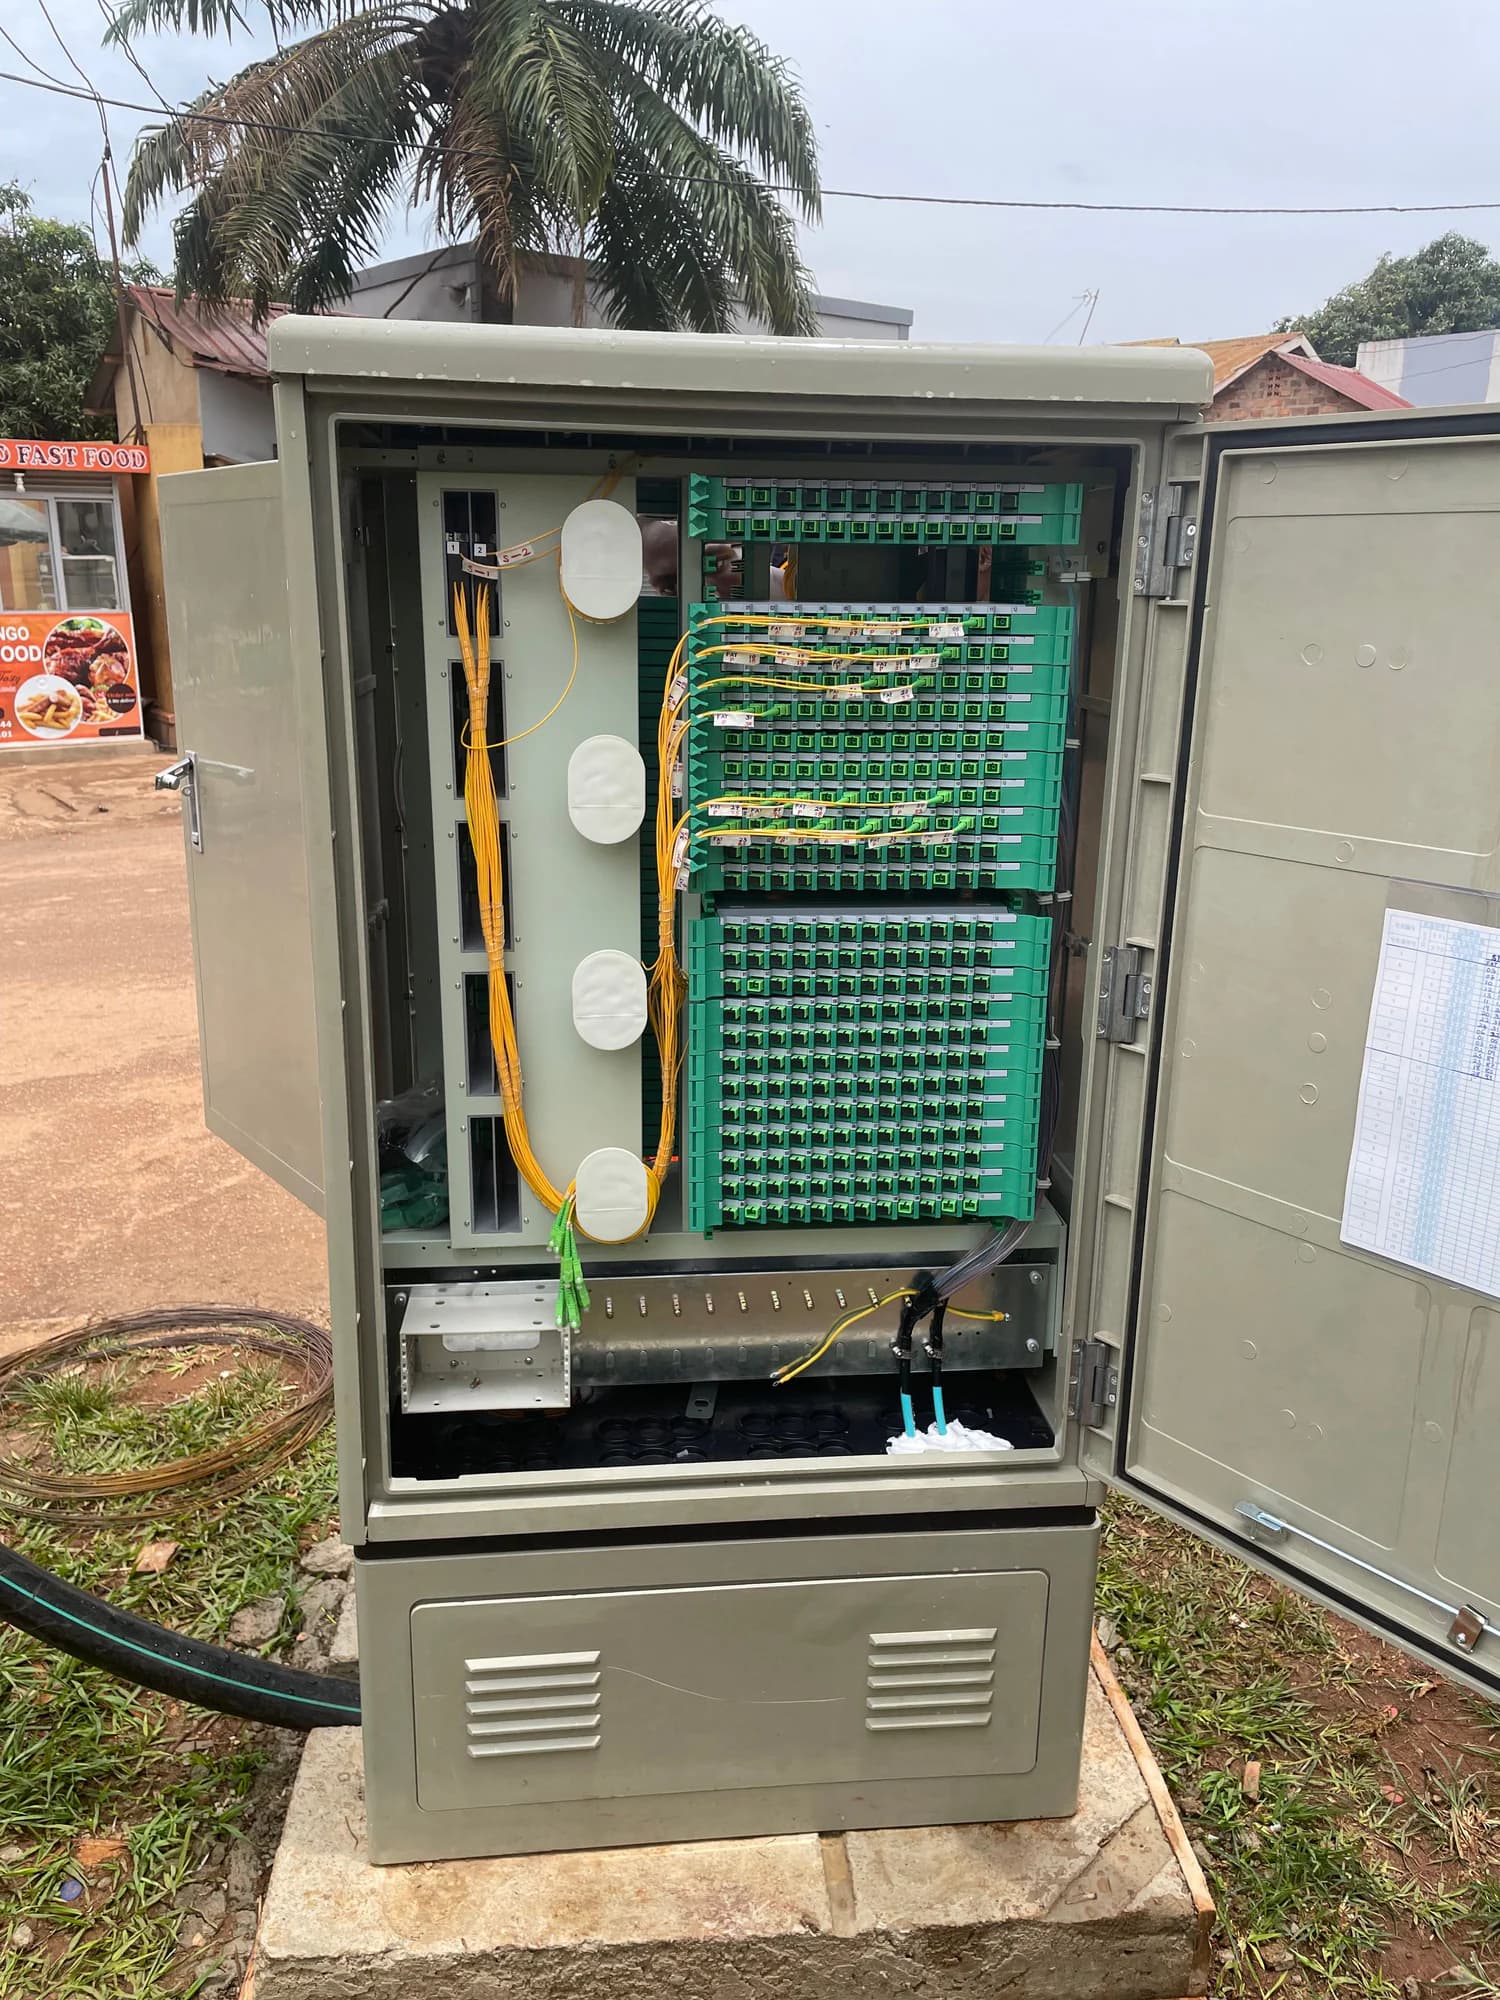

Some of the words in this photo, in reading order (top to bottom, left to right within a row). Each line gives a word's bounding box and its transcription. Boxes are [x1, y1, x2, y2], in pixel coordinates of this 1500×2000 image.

[16, 445, 78, 465] FAST
[83, 447, 147, 468] FOOD
[1, 645, 42, 662] OOD
